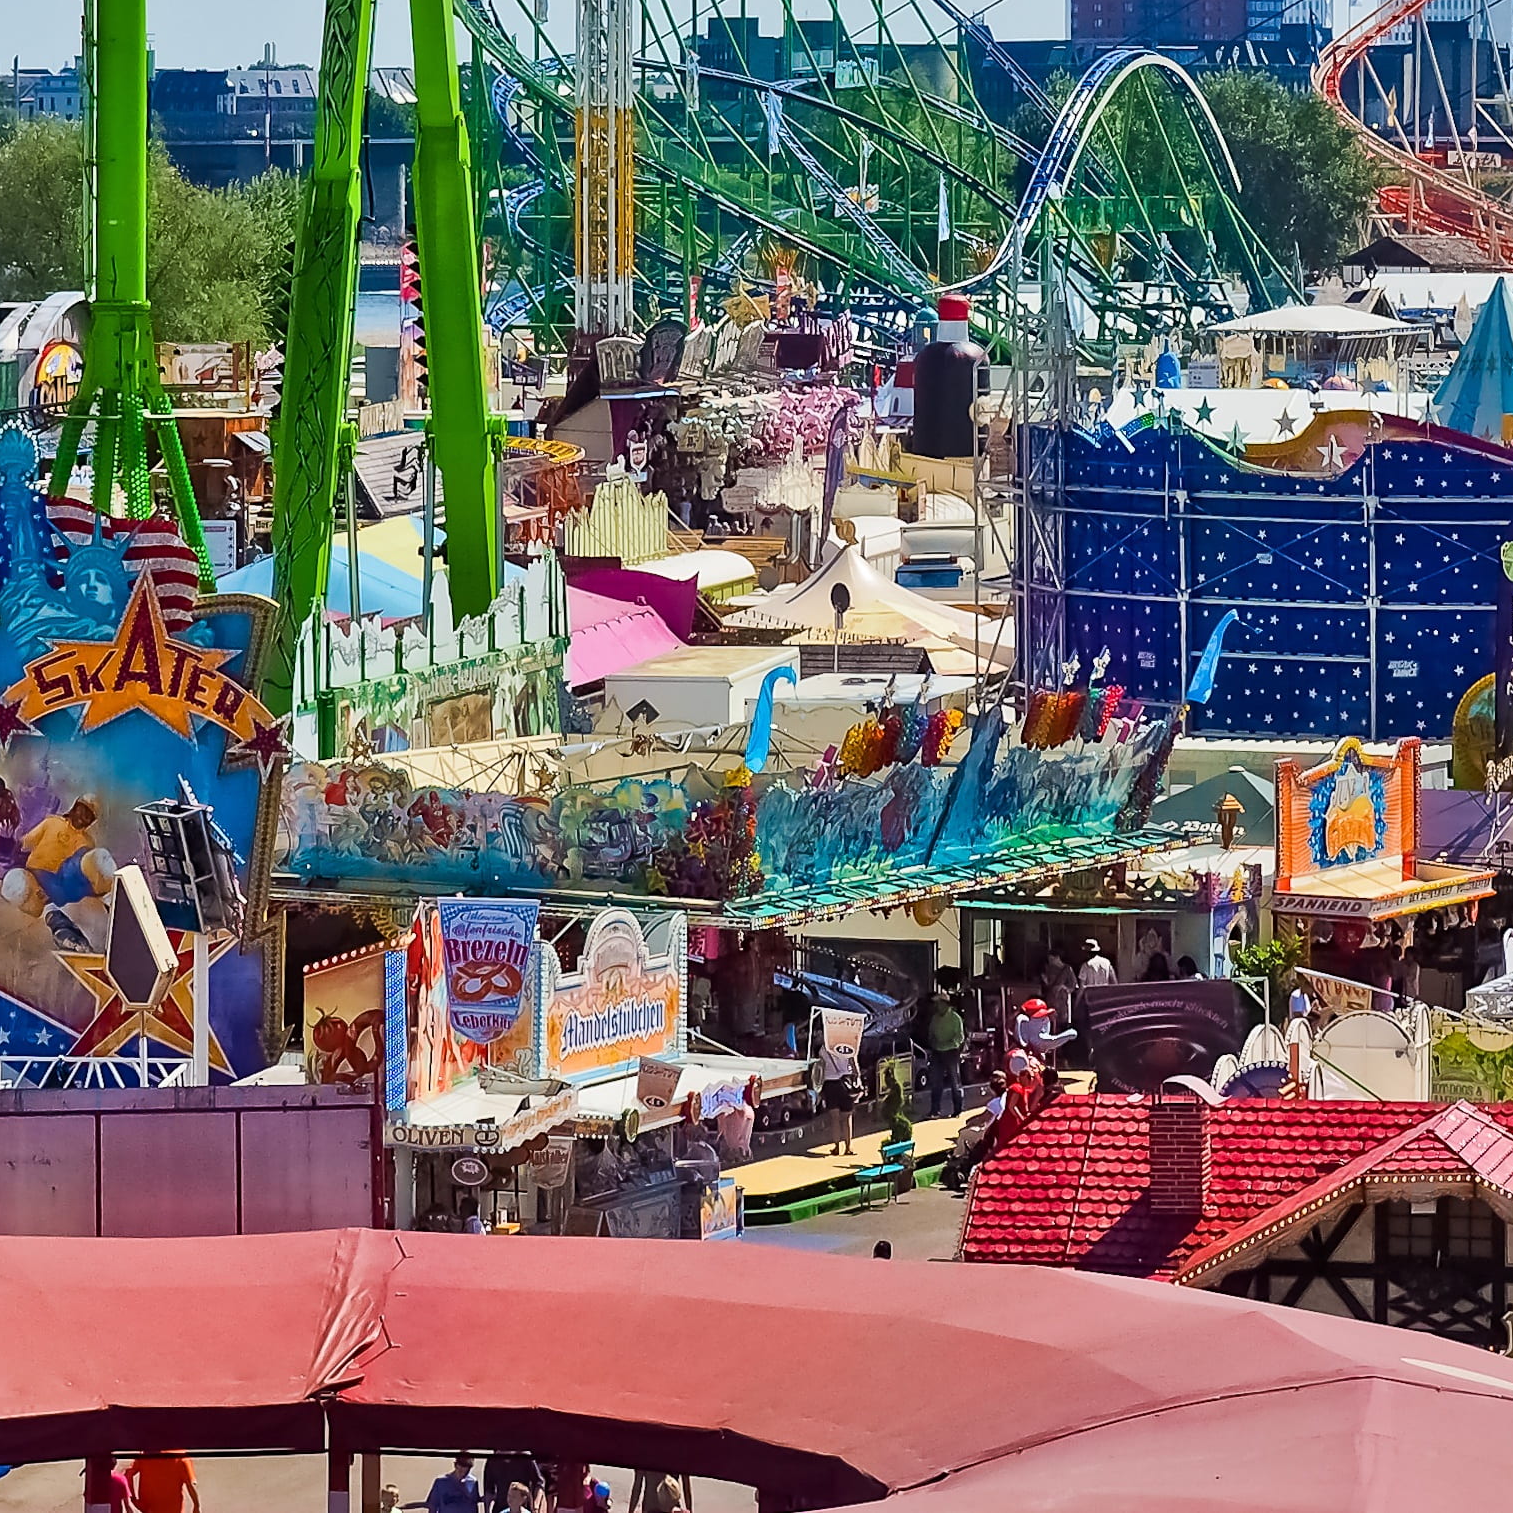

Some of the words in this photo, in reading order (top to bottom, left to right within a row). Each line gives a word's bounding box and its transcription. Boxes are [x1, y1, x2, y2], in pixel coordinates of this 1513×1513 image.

[31, 584, 246, 724] SKATER
[1274, 896, 1363, 914] SPANNEND
[444, 937, 529, 966] Brezeln
[560, 996, 666, 1057] Mandelstübchen
[392, 1127, 465, 1147] OLIVEN
